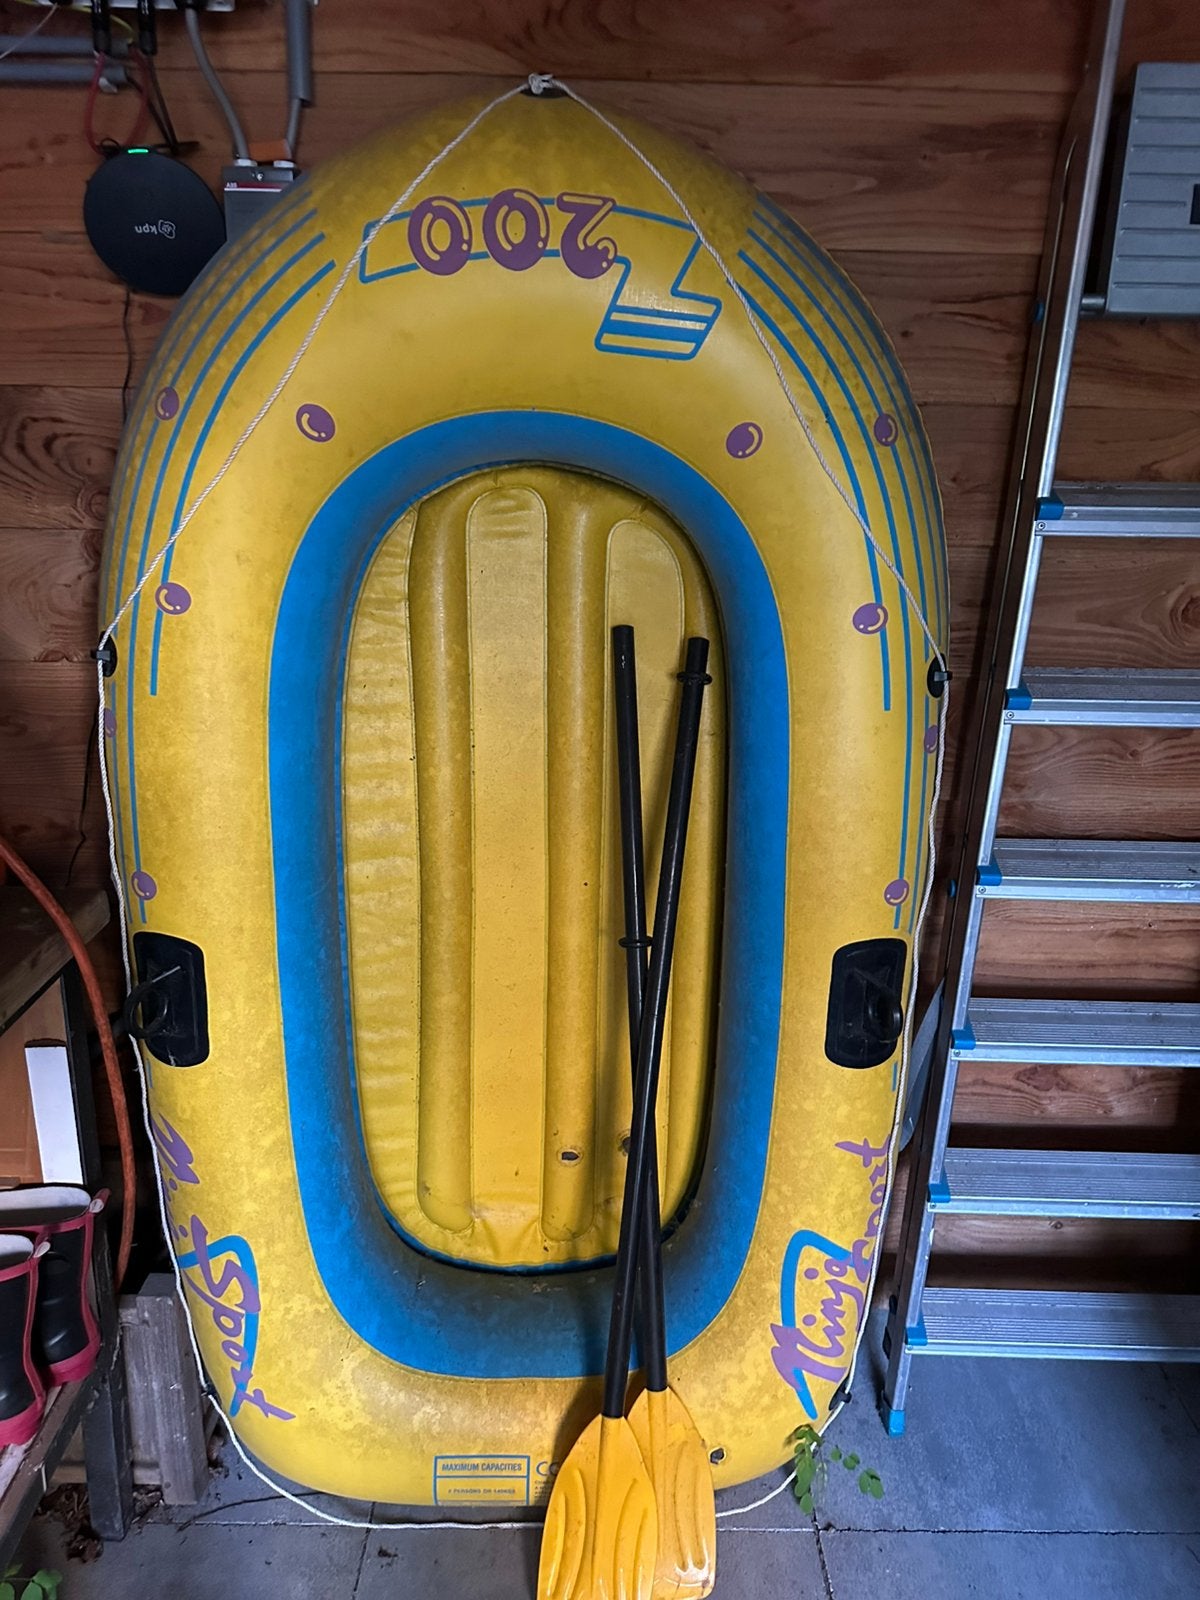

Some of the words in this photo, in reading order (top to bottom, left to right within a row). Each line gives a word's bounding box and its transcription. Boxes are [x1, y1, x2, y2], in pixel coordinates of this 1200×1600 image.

[134, 223, 158, 235] kpn
[407, 187, 618, 280] 200
[183, 1214, 296, 1420] Sport
[769, 1255, 864, 1392] Ninja
[441, 1462, 479, 1472] MAXIMUM
[481, 1462, 522, 1472] CAPACITIES
